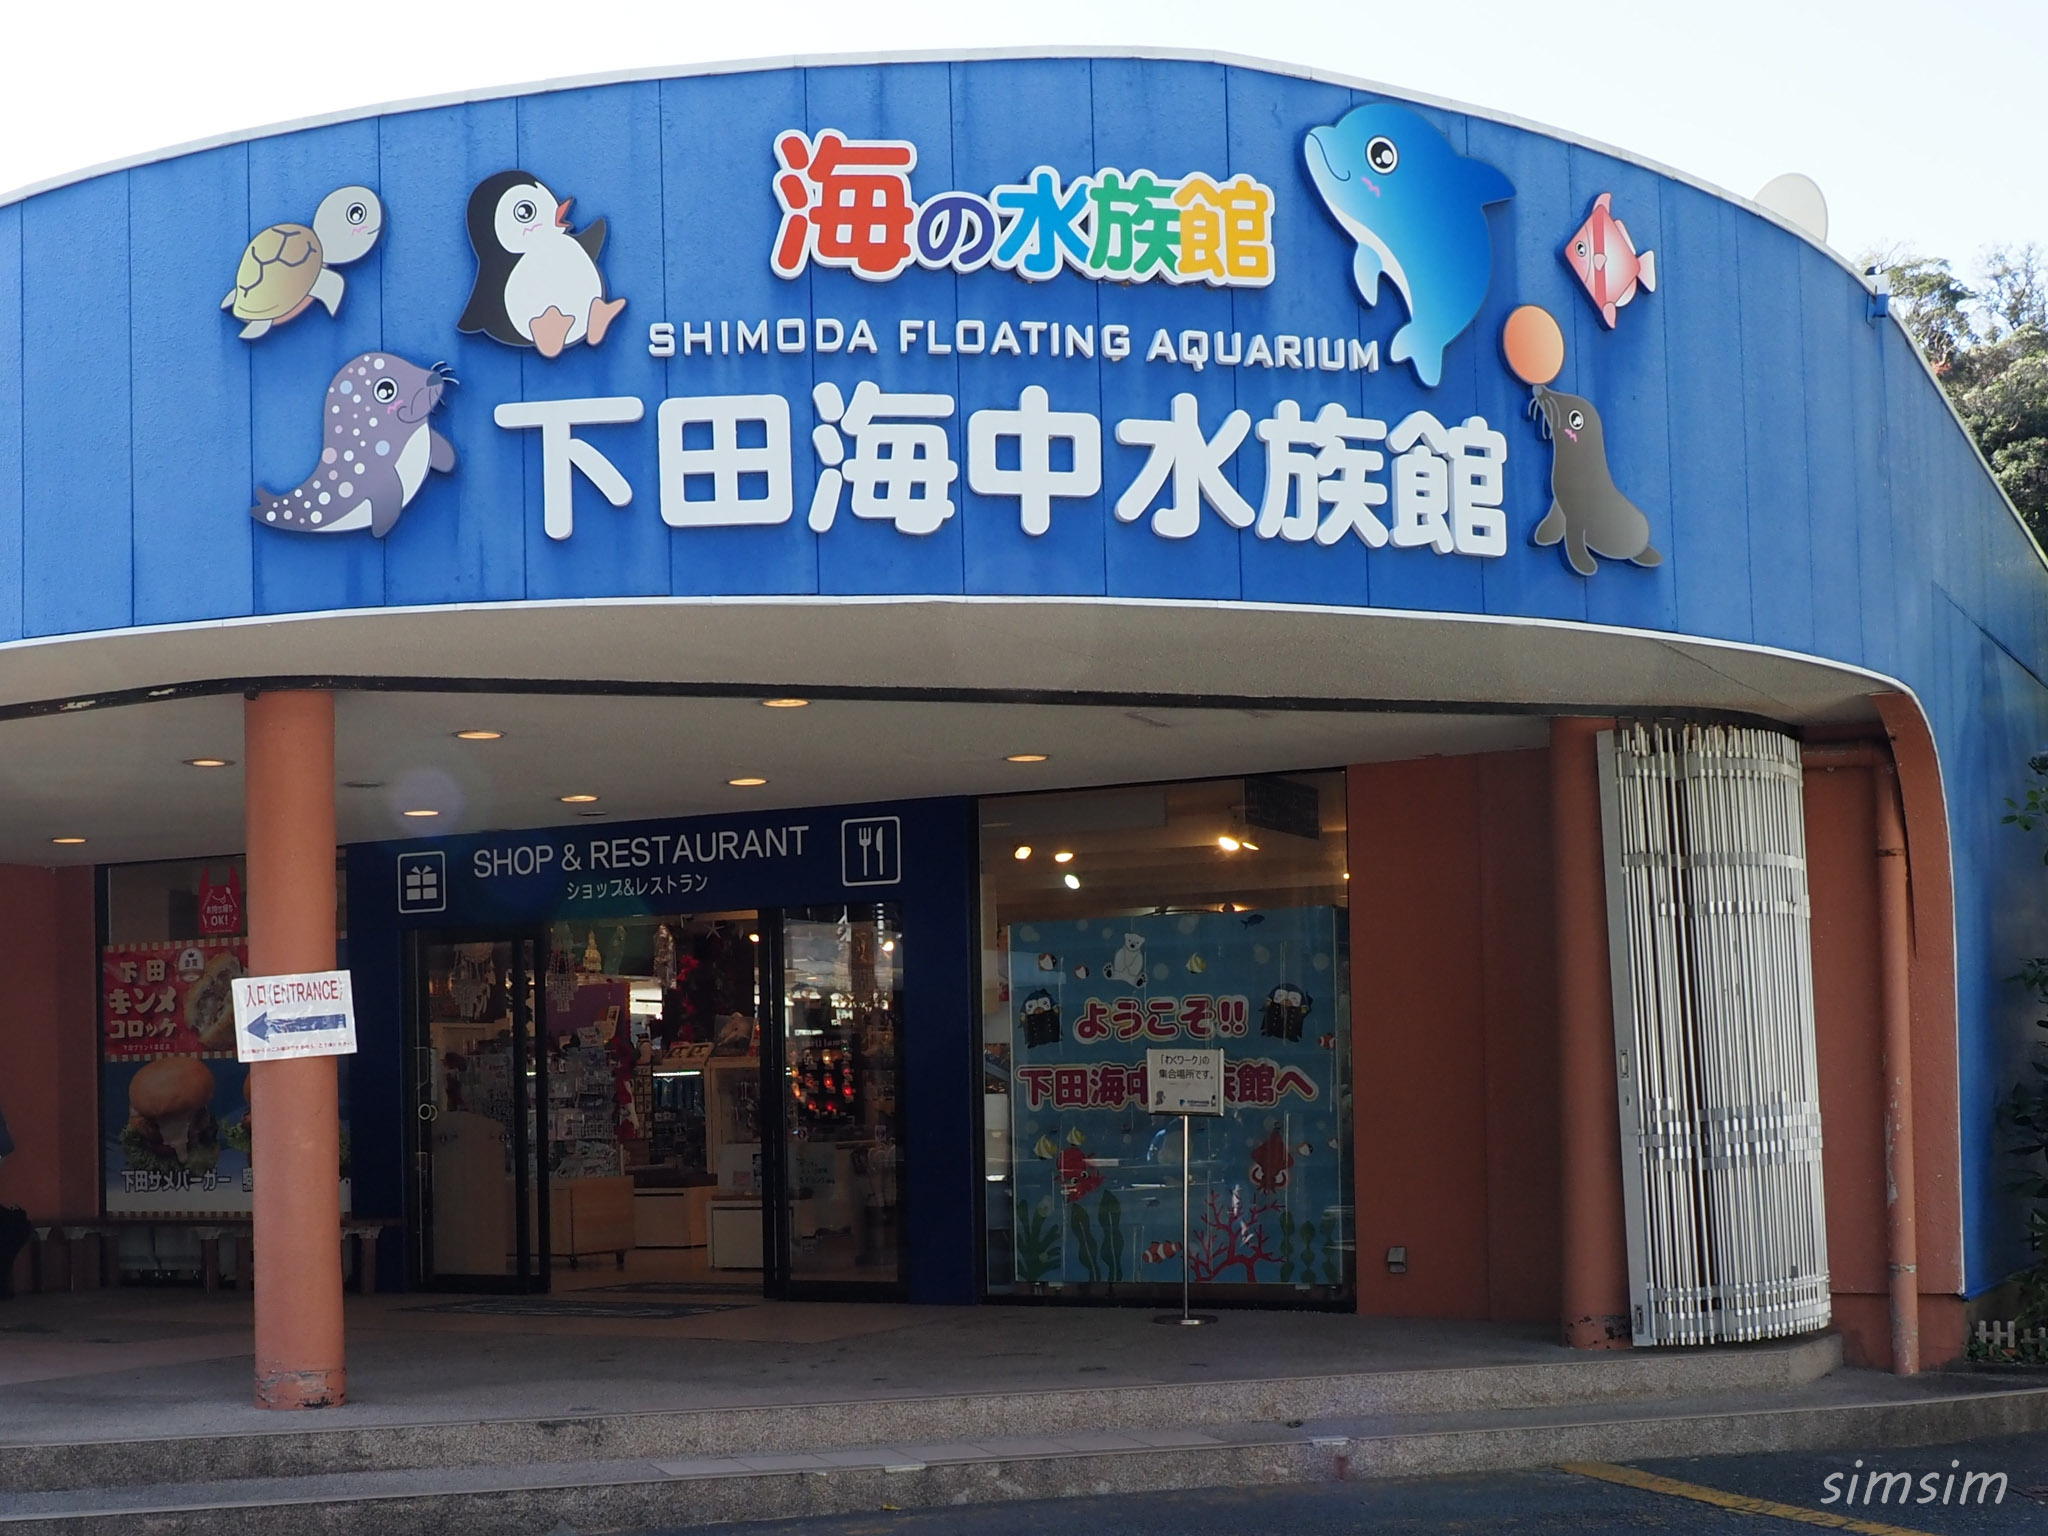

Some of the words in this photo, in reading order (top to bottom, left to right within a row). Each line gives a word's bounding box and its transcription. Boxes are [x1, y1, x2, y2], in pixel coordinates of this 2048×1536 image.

[771, 128, 1276, 289] 海の水族館
[648, 317, 878, 357] SHIMODA
[899, 318, 1131, 362] FLOATING
[1147, 326, 1380, 372] AQUARIUM
[494, 380, 1508, 558] 下田海中水族館
[474, 845, 554, 878] SHOP
[562, 843, 582, 872] &
[590, 825, 810, 870] RESTAURANT
[566, 873, 708, 901] ショップ&レストラン
[210, 915, 228, 927] OK!
[119, 958, 167, 983] 下田
[109, 986, 177, 1015] キンメ
[109, 1019, 178, 1039] コロッケ
[1158, 1068, 1214, 1080] 集合場所です。
[121, 1168, 232, 1193] 下田サメバーガー
